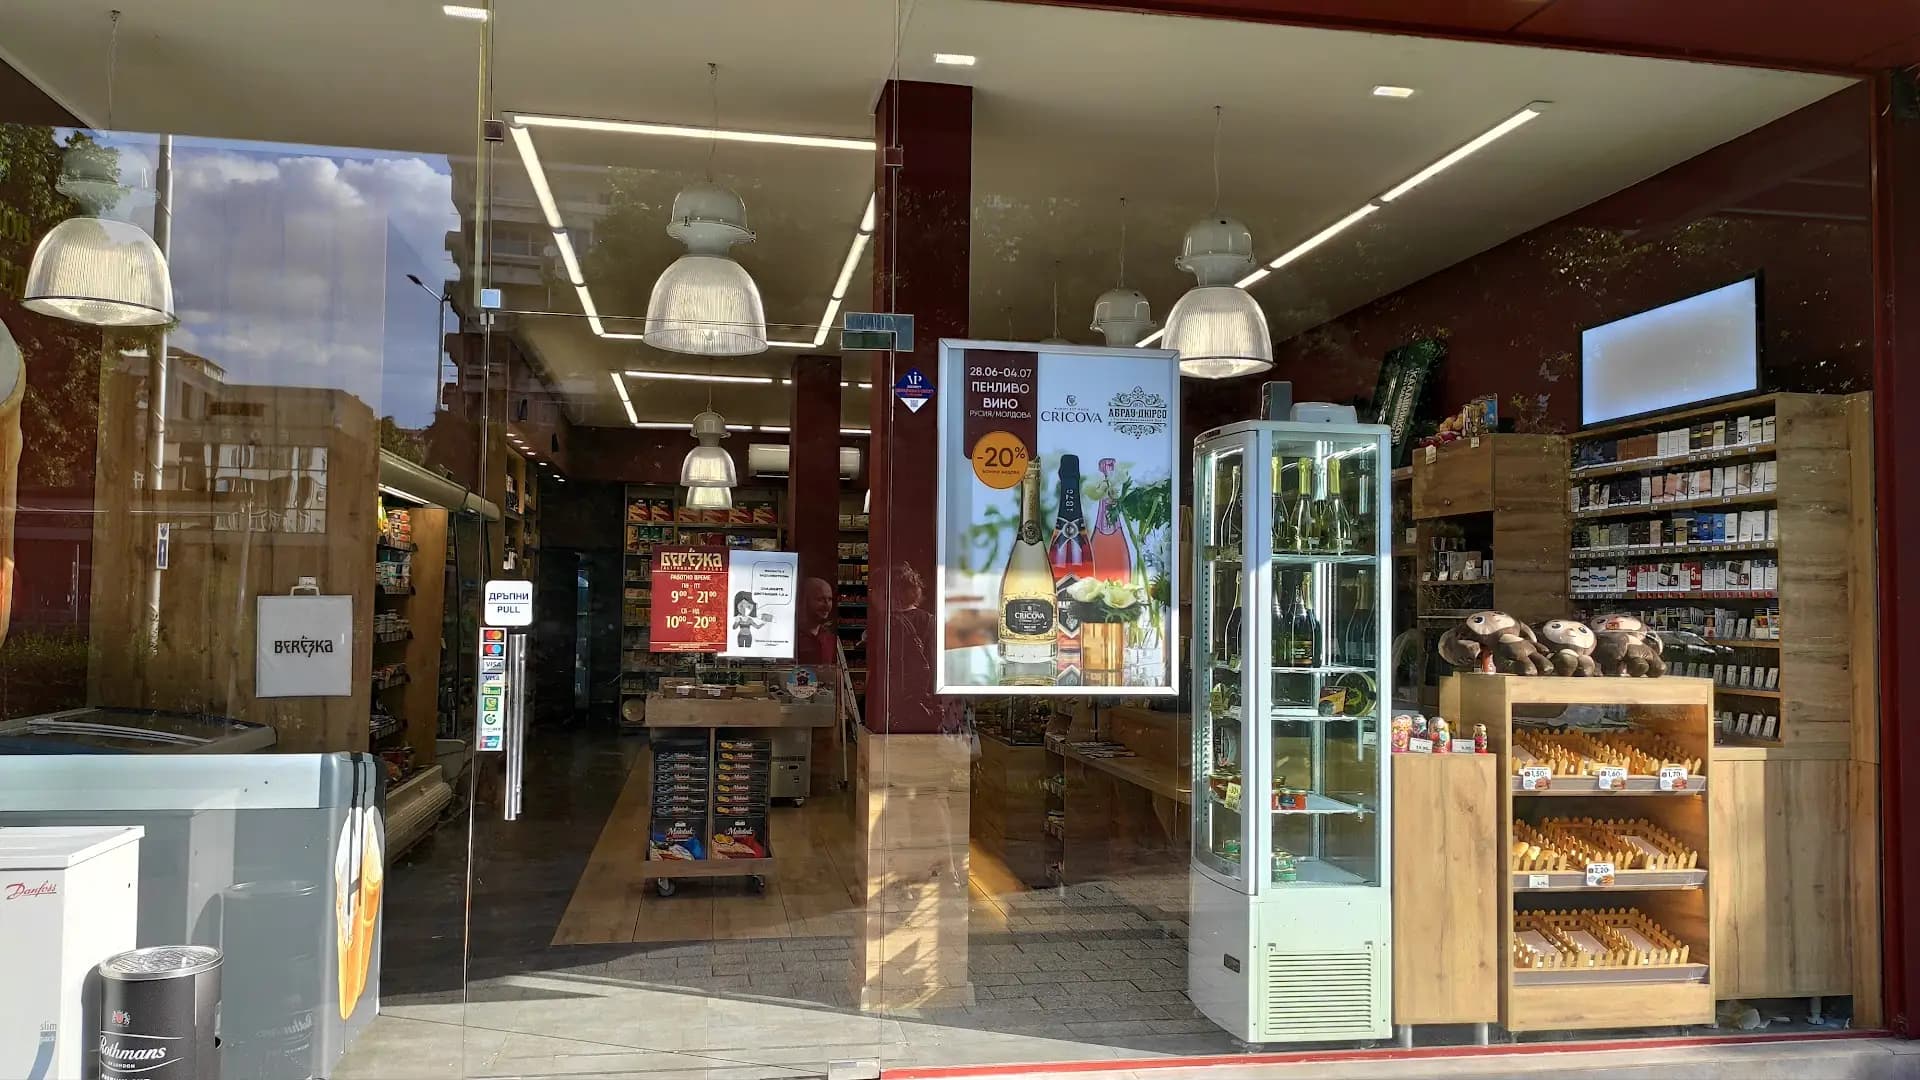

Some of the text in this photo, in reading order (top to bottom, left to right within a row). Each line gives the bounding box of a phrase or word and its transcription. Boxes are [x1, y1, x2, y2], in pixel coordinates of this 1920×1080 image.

[969, 366, 1032, 378] 28.06-04.07
[971, 381, 1030, 394] ПЕНЛИВО
[983, 397, 1019, 409] ВИНО
[1041, 410, 1102, 423] CRICOVA
[976, 446, 1026, 467] -20%
[488, 592, 529, 601] ДРЪПНИ
[497, 605, 521, 614] PULL
[1014, 612, 1045, 620] CRICOVA
[5, 880, 57, 900] Danfoss
[40, 1021, 57, 1031] slim
[100, 1035, 167, 1060] Rothmans
